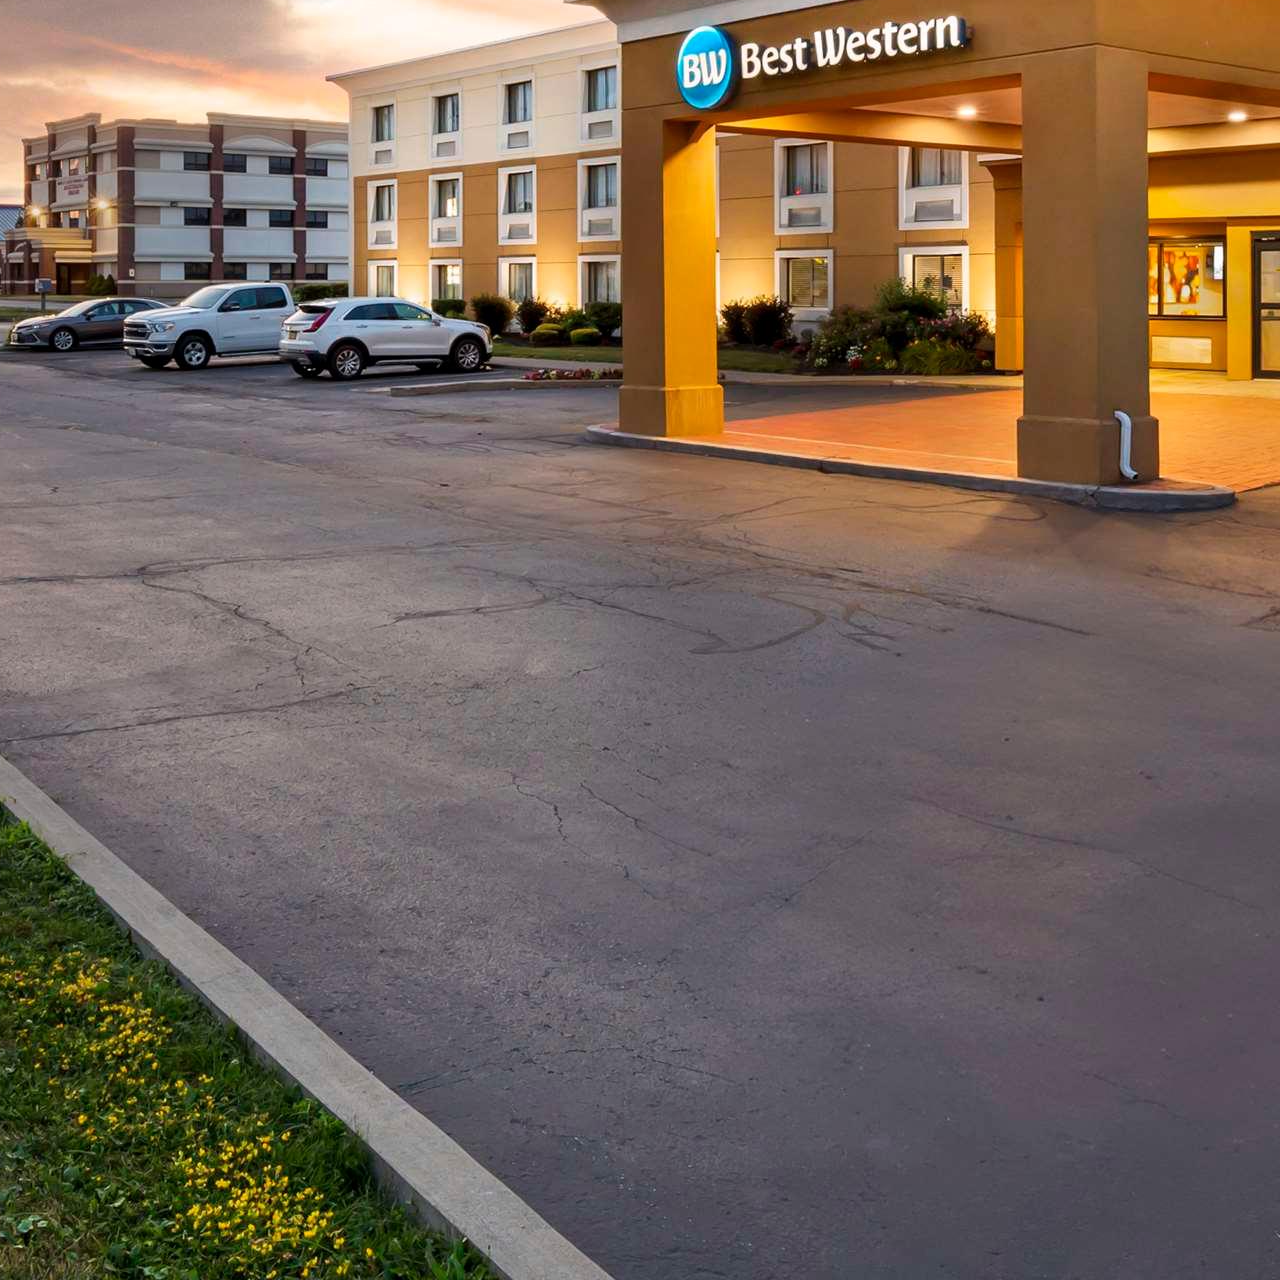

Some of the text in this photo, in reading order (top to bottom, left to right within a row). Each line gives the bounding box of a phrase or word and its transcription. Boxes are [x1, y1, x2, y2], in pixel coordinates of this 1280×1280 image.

[682, 49, 727, 89] BW
[740, 15, 961, 79] Best Western
